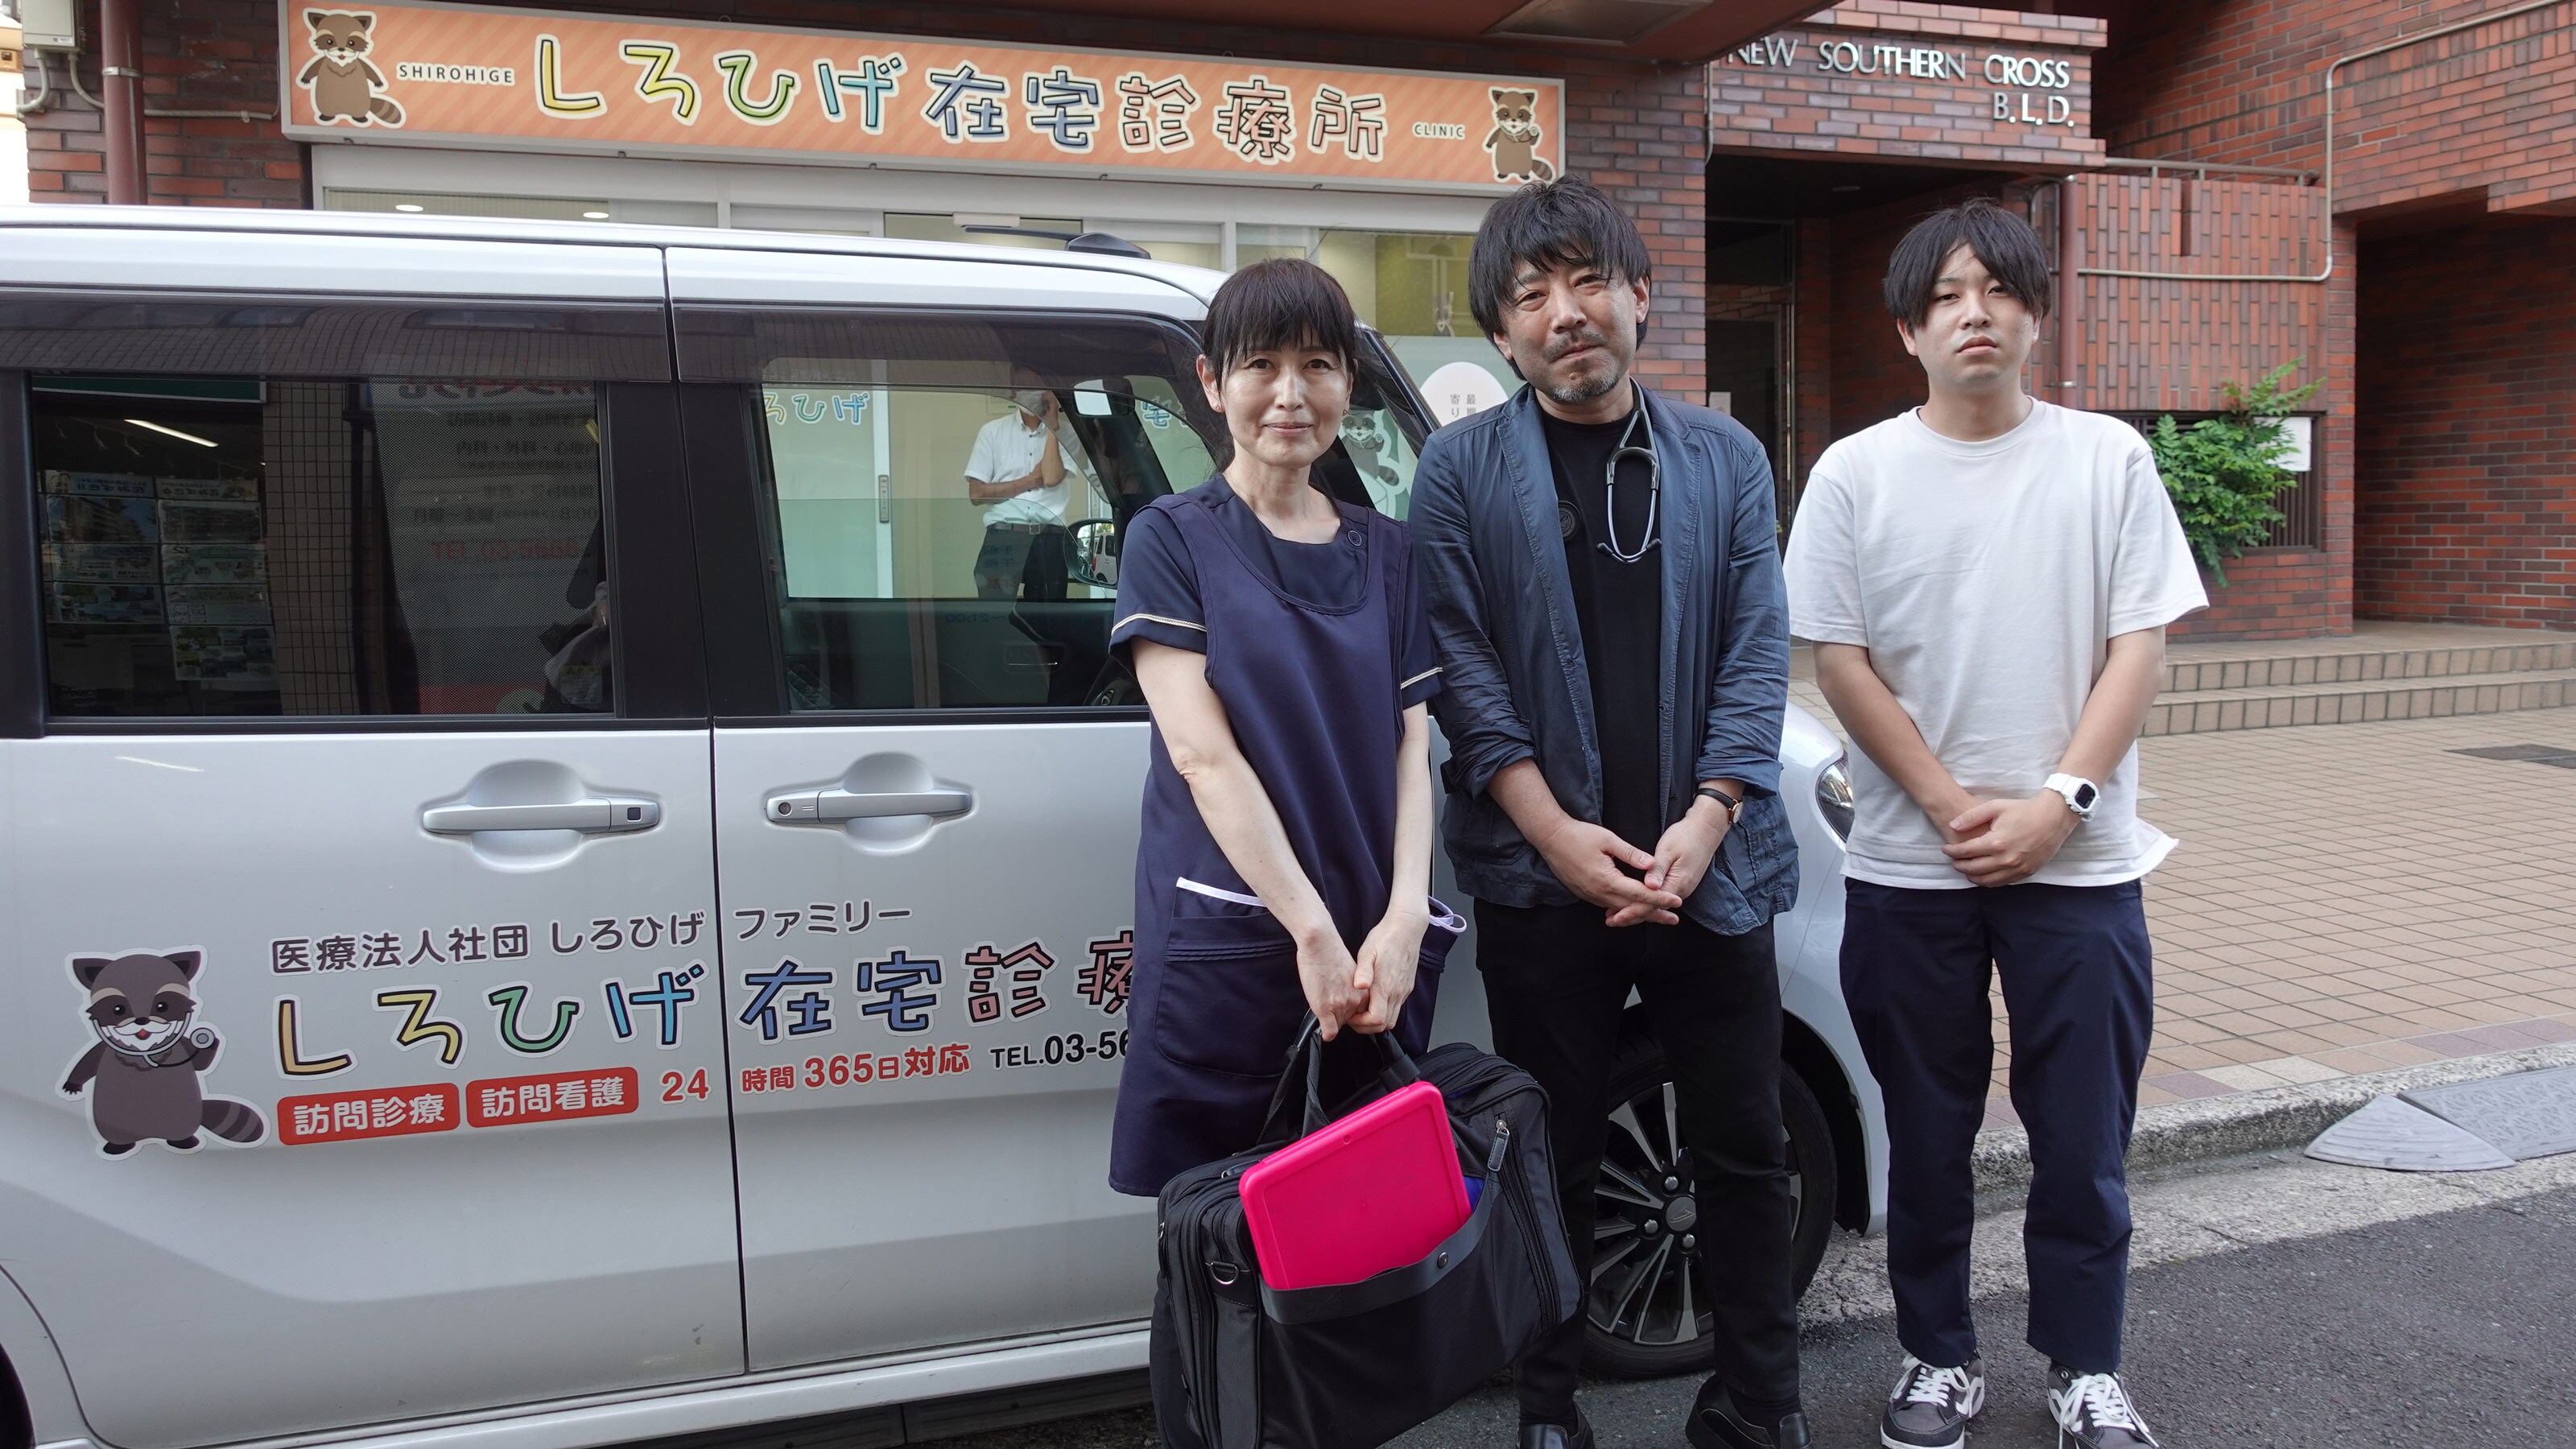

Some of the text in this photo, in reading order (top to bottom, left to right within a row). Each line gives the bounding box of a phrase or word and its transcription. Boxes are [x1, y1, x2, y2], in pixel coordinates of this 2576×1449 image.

[398, 64, 514, 85] SHIROHIGE
[1818, 40, 1967, 80] SOUTHERN
[1984, 54, 2070, 89] CROSS
[539, 39, 1388, 159] しろひげ在宅診療所
[1993, 93, 2074, 127] B.L.D.
[1413, 122, 1465, 139] CLINIC
[273, 900, 910, 972] 医療法人社団 しろひげ ファミリー
[293, 1090, 446, 1136] 訪問診療
[481, 1076, 625, 1119] 訪問看護
